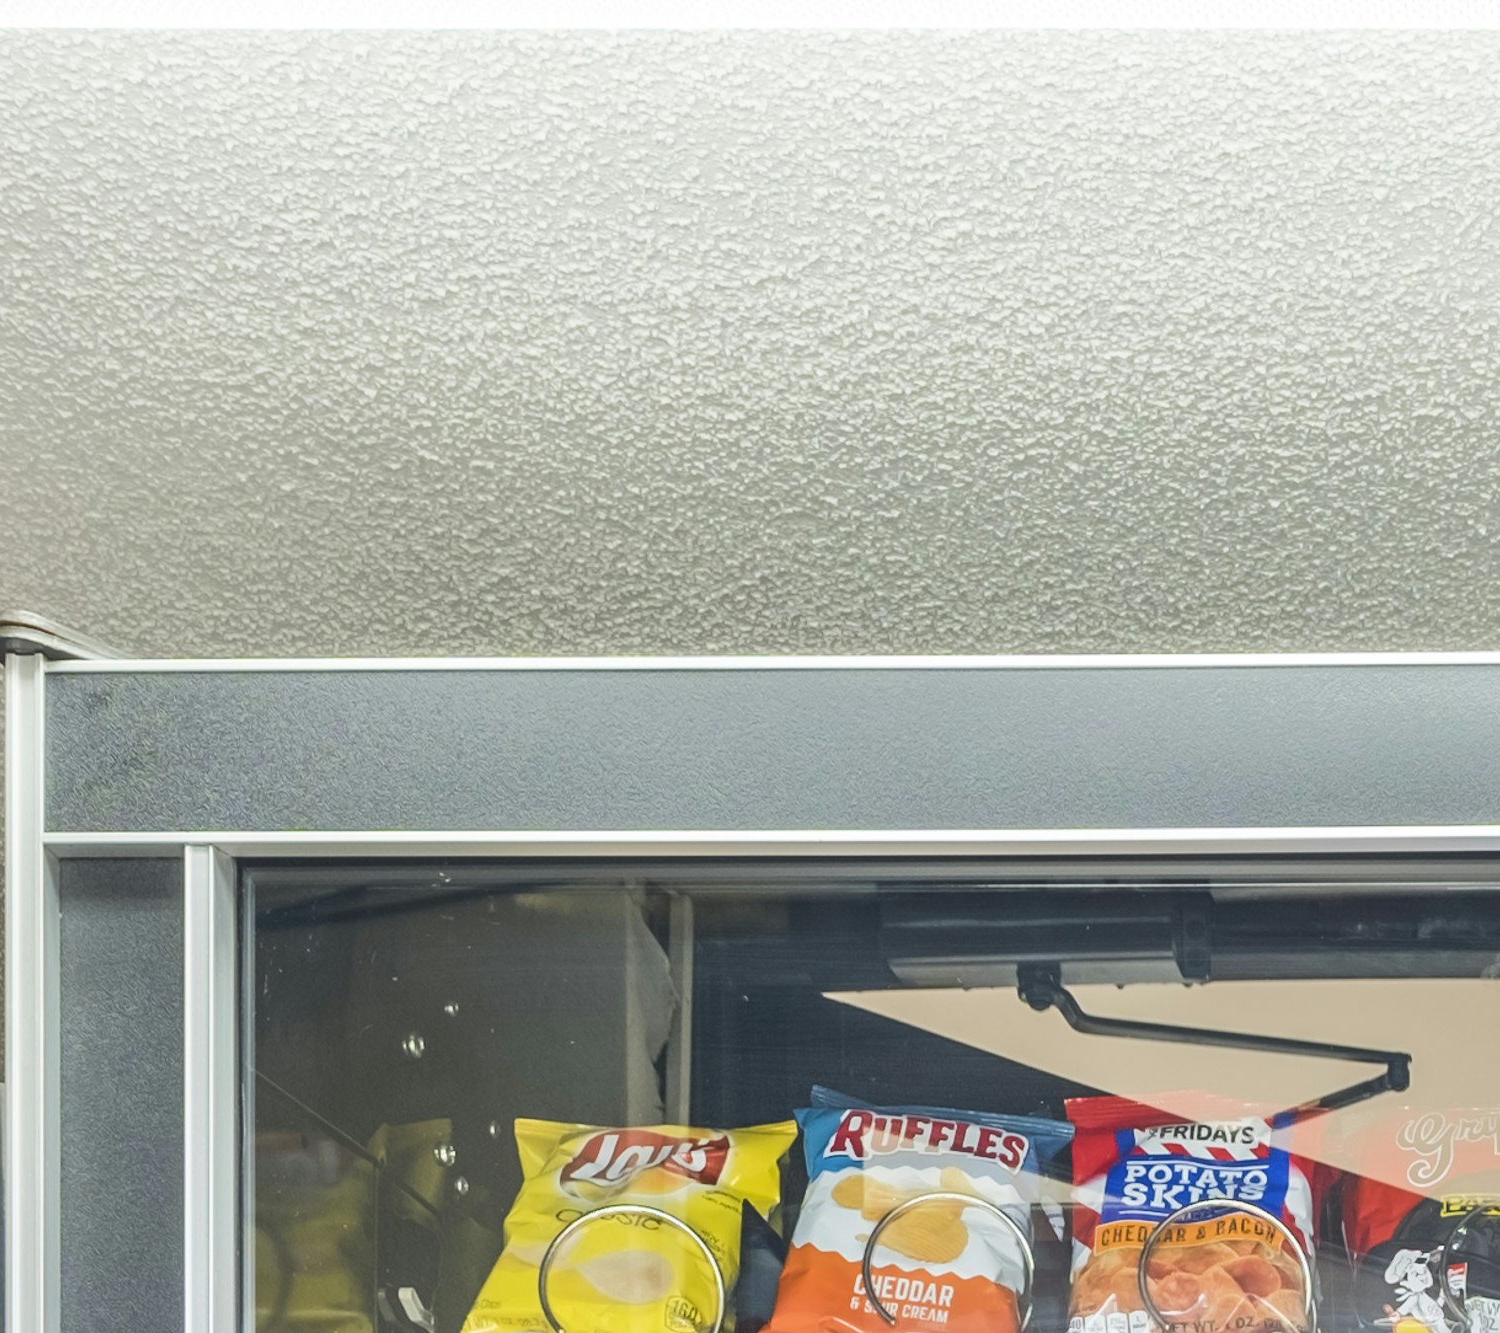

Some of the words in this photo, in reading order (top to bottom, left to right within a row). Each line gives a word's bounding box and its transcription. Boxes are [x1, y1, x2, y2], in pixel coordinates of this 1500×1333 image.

[829, 1109, 1026, 1170] RUFFLES
[1157, 1124, 1256, 1144] FRIDAYS
[1123, 1164, 1269, 1189] POTATO
[1121, 1182, 1264, 1210] SKINS
[863, 1300, 898, 1317] SUR
[901, 1303, 949, 1324] CREAM
